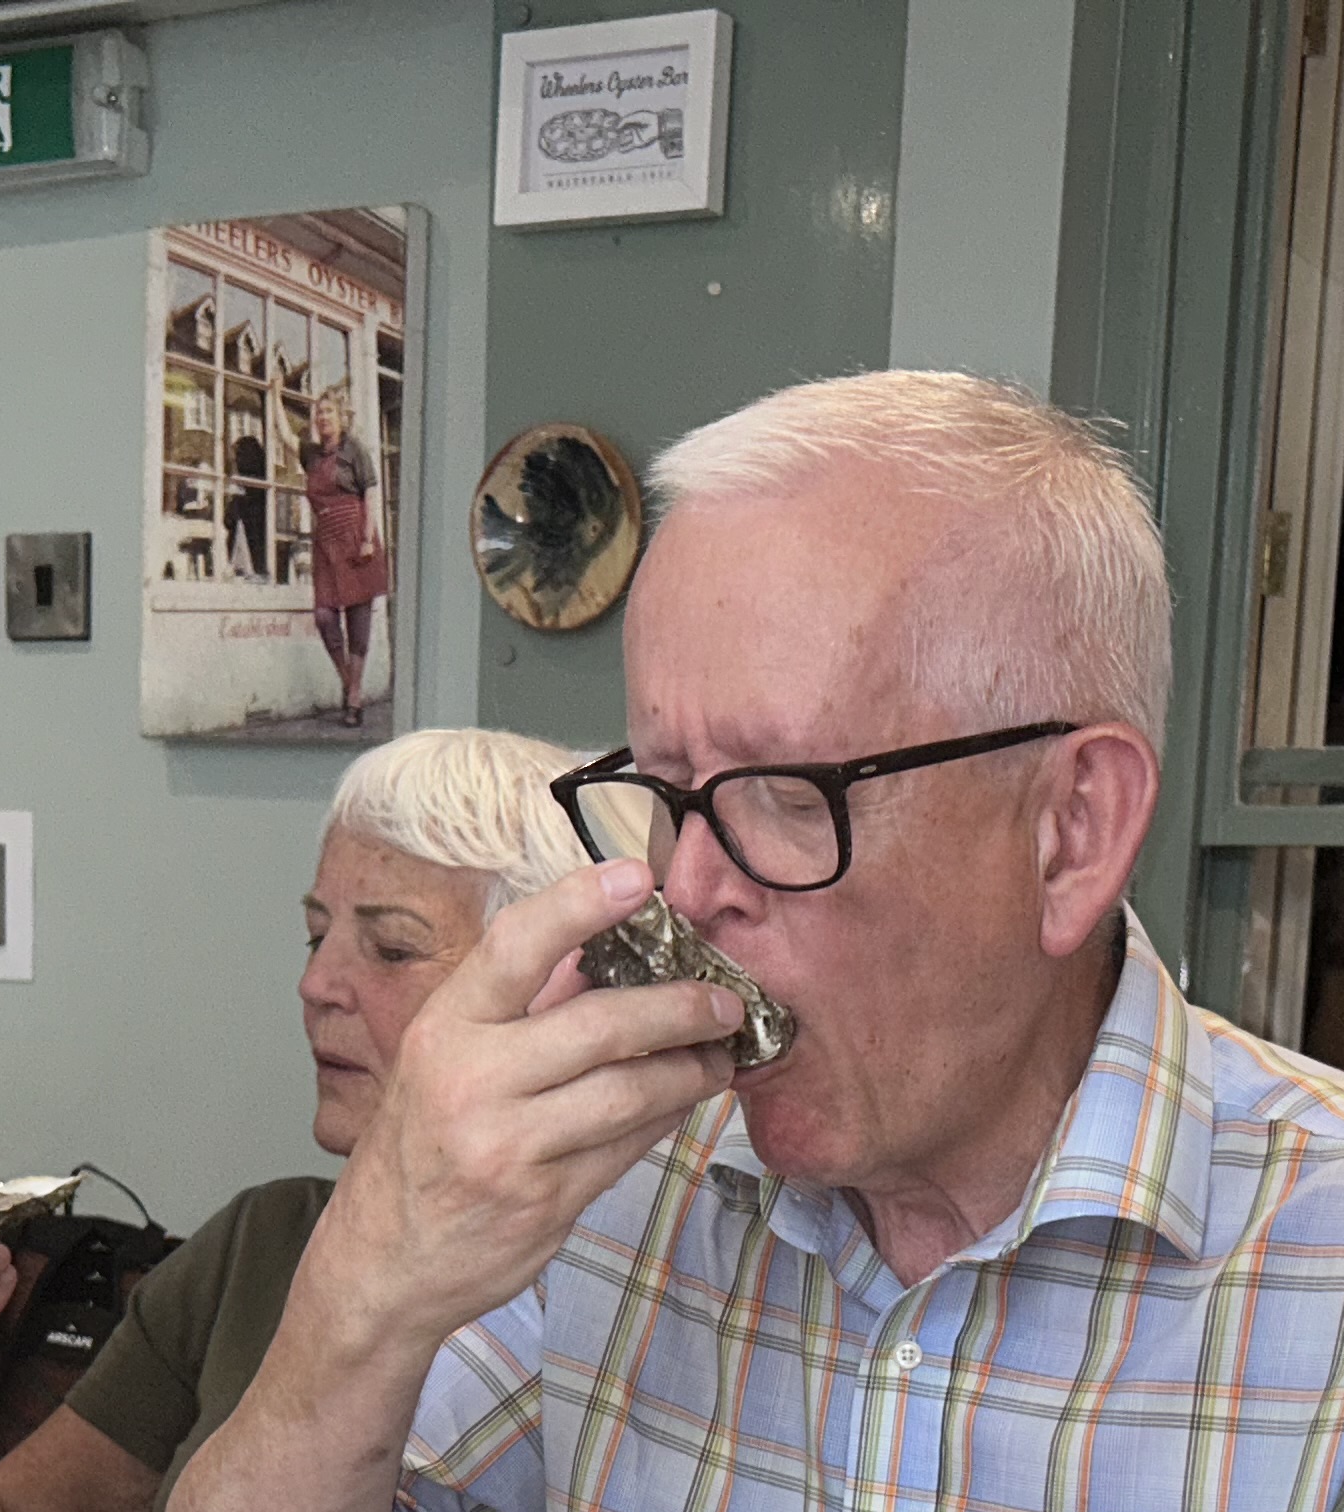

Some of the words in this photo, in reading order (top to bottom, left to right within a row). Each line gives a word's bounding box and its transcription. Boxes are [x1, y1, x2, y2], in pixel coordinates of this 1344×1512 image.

[607, 70, 654, 99] Oyster
[197, 221, 292, 273] HEELERS
[308, 262, 378, 311] OYSTER
